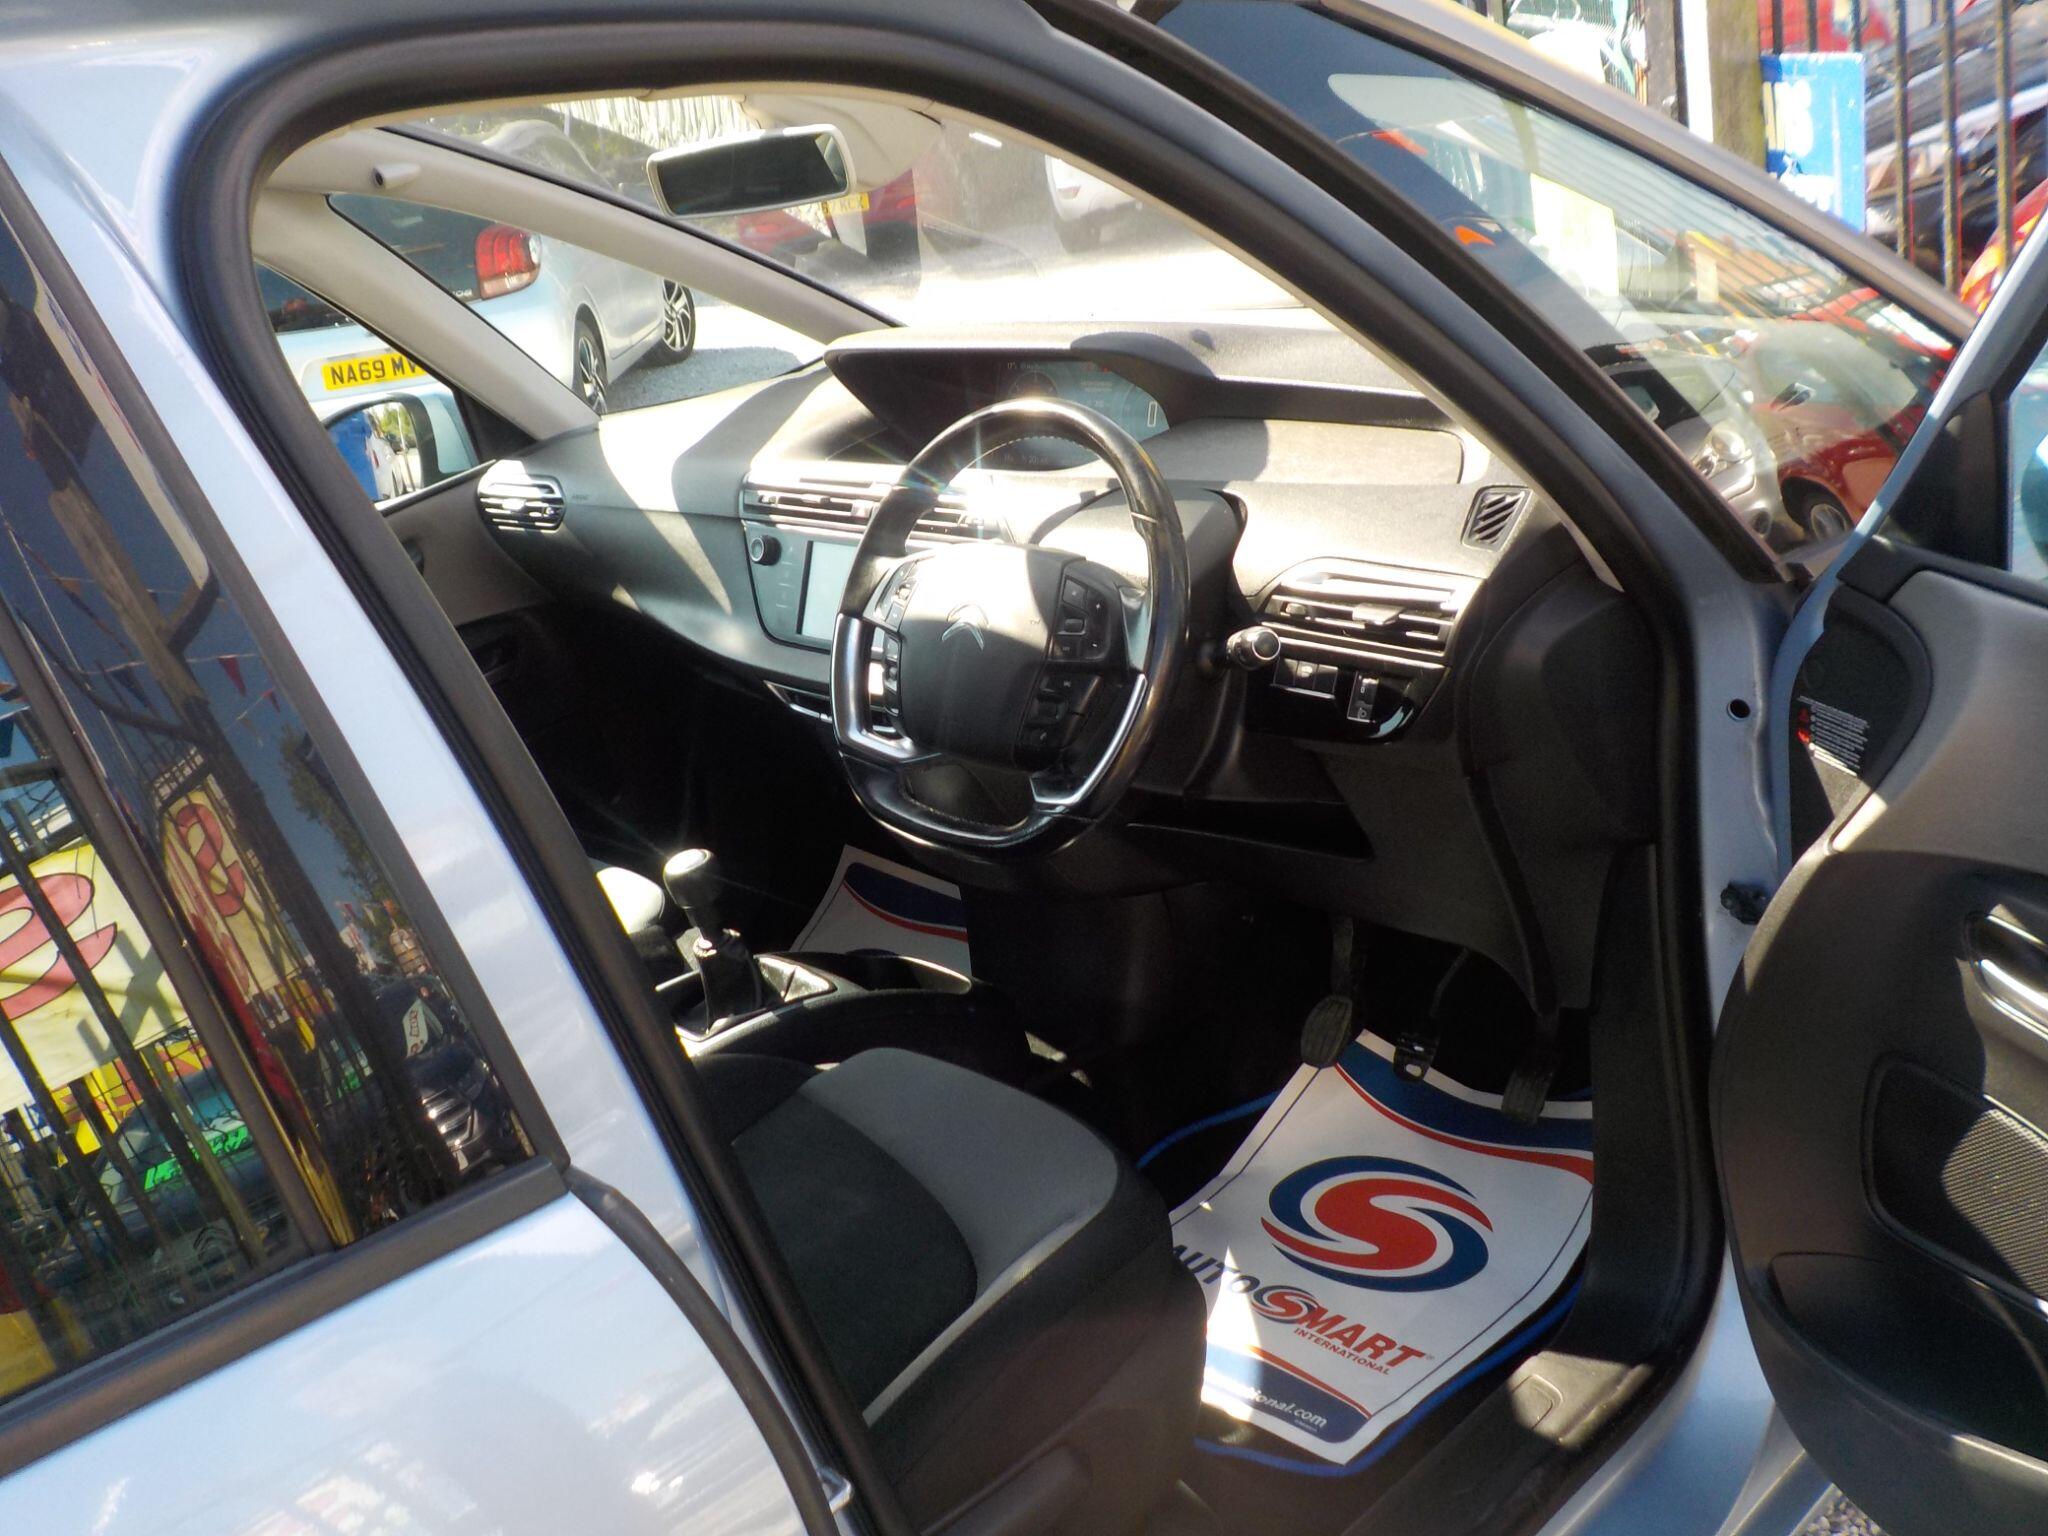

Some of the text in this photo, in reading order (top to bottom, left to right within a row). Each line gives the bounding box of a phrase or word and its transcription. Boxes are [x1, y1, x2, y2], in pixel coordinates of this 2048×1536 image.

[330, 359, 386, 385] NA69
[1293, 1327, 1390, 1375] INTERNATIONAL
[1252, 1387, 1328, 1428] ional.com
